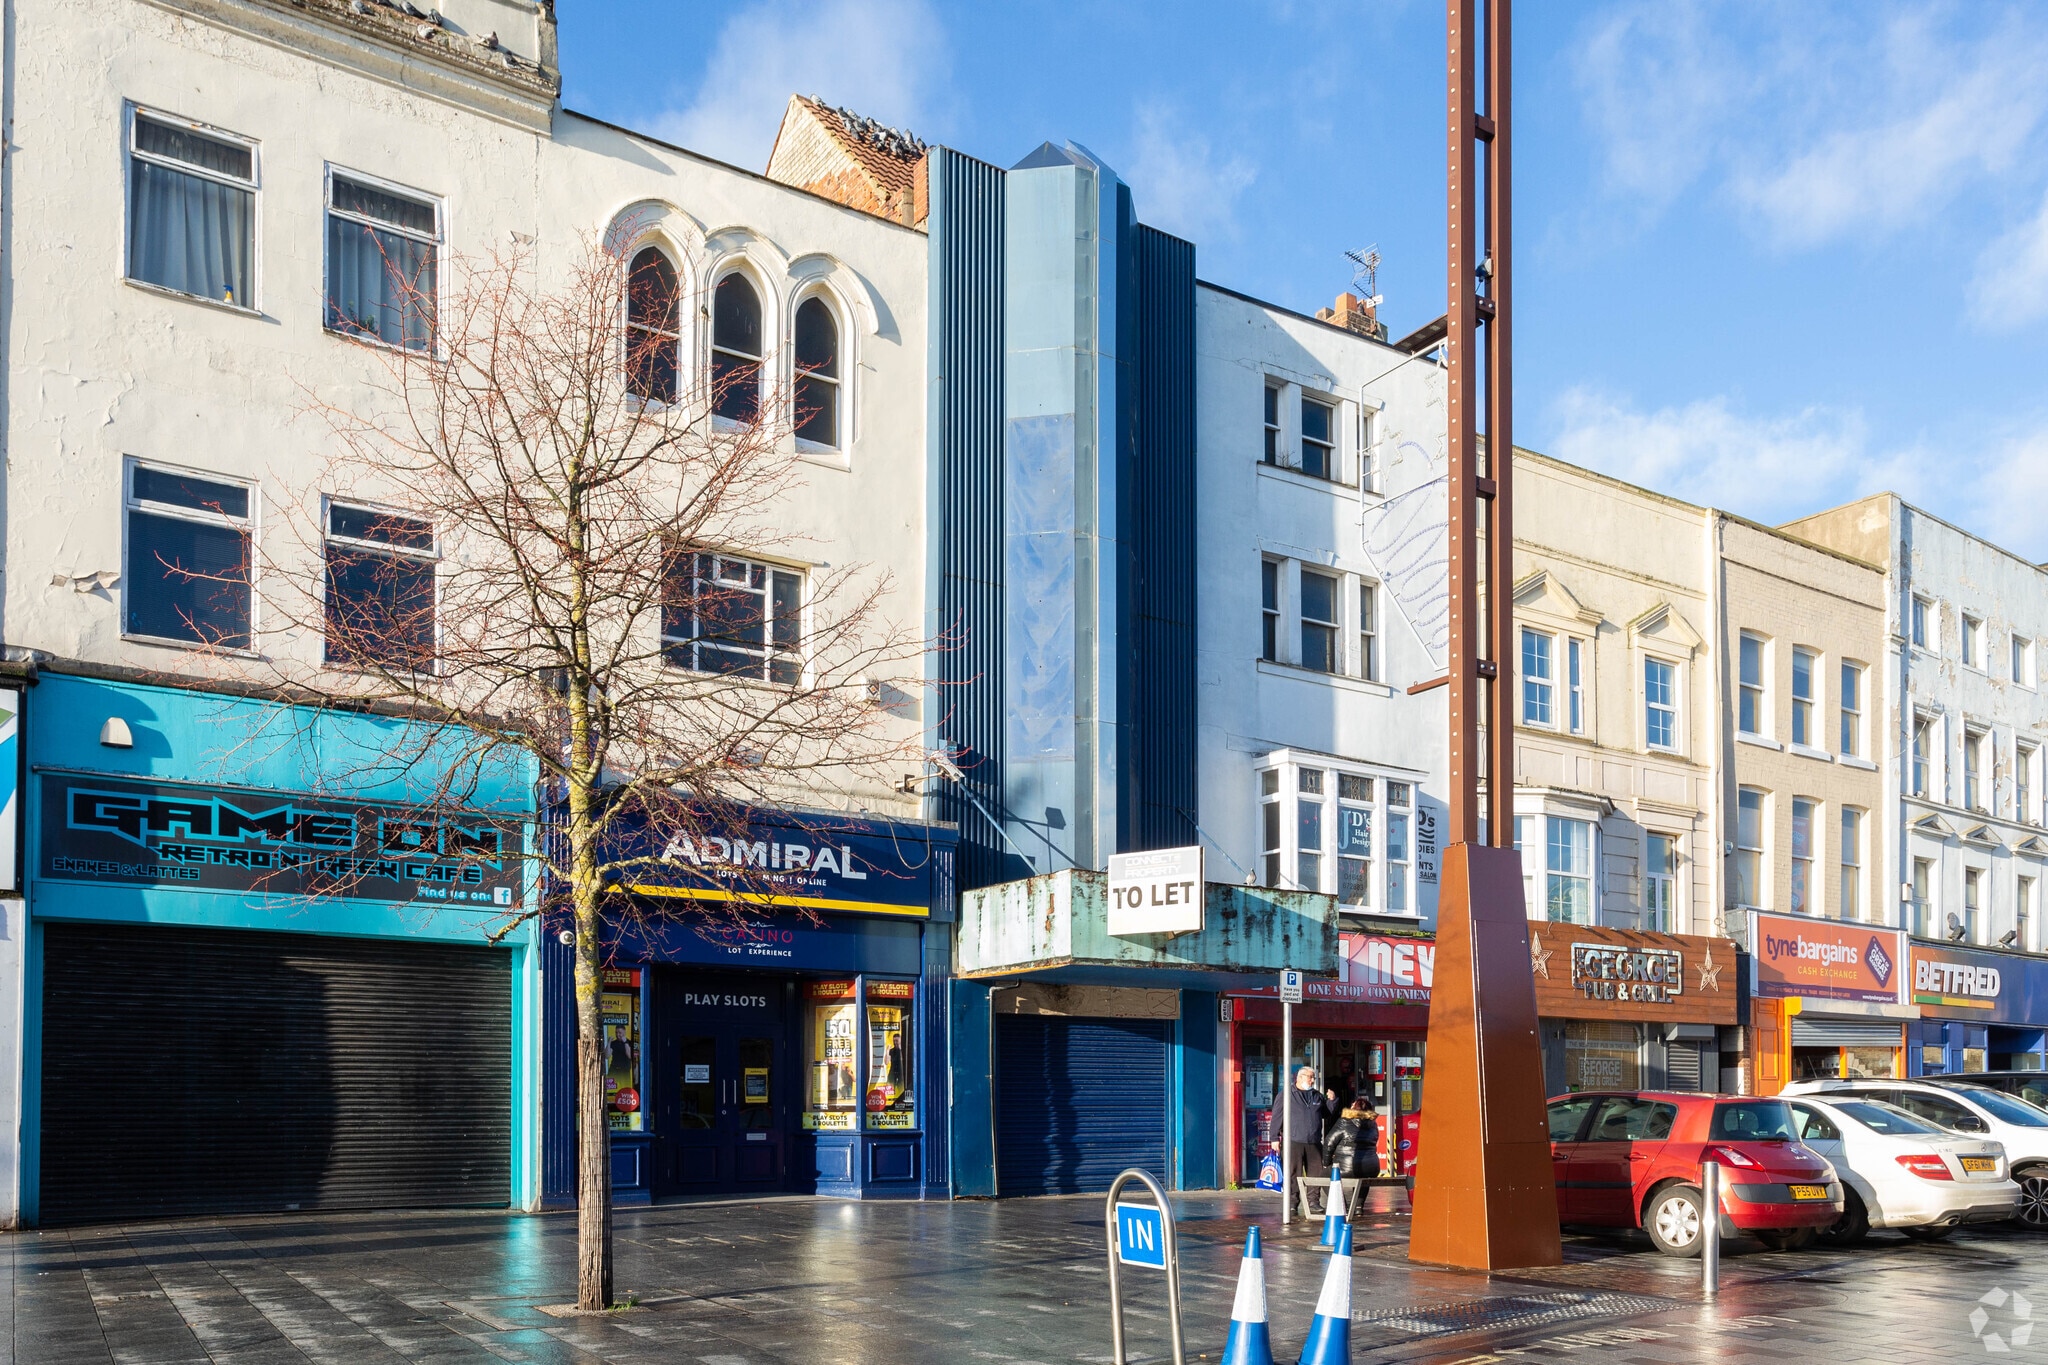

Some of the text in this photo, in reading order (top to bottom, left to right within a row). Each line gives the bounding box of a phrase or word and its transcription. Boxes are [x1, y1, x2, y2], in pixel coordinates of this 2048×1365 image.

[1418, 809, 1436, 828] D's
[67, 787, 503, 872] GAME ON
[1355, 829, 1370, 838] Hair
[147, 842, 272, 870] RETRO
[315, 855, 400, 884] GEEK
[661, 828, 867, 880] ADMIRAL
[53, 856, 200, 880] SNAKES & LATTES
[708, 868, 739, 879] LOTS
[1125, 865, 1181, 879] PROPERTY
[449, 889, 469, 900] us
[1113, 881, 1194, 909] TO LET
[721, 926, 794, 944] CASINO
[722, 946, 792, 957] LOT EXPERIENCE
[1766, 934, 1858, 967] tynebargains
[1585, 949, 1678, 984] GEORGE
[1870, 948, 1889, 975] GREAT
[1798, 966, 1858, 980] CASH EXCHANGE
[1915, 959, 2000, 997] BETFRED
[828, 982, 848, 990] SLOTS
[1308, 983, 1332, 996] ONE
[1335, 984, 1365, 997] STOP
[1584, 981, 1673, 1003] PUB & GRILL
[685, 993, 767, 1007] PLAY SLOTS
[825, 1020, 851, 1038] 50
[826, 1039, 851, 1049] FREE
[826, 1048, 852, 1057] SPINS
[1584, 1060, 1620, 1075] GEORGE
[617, 1097, 637, 1106] £500
[1127, 1217, 1154, 1251] IN
